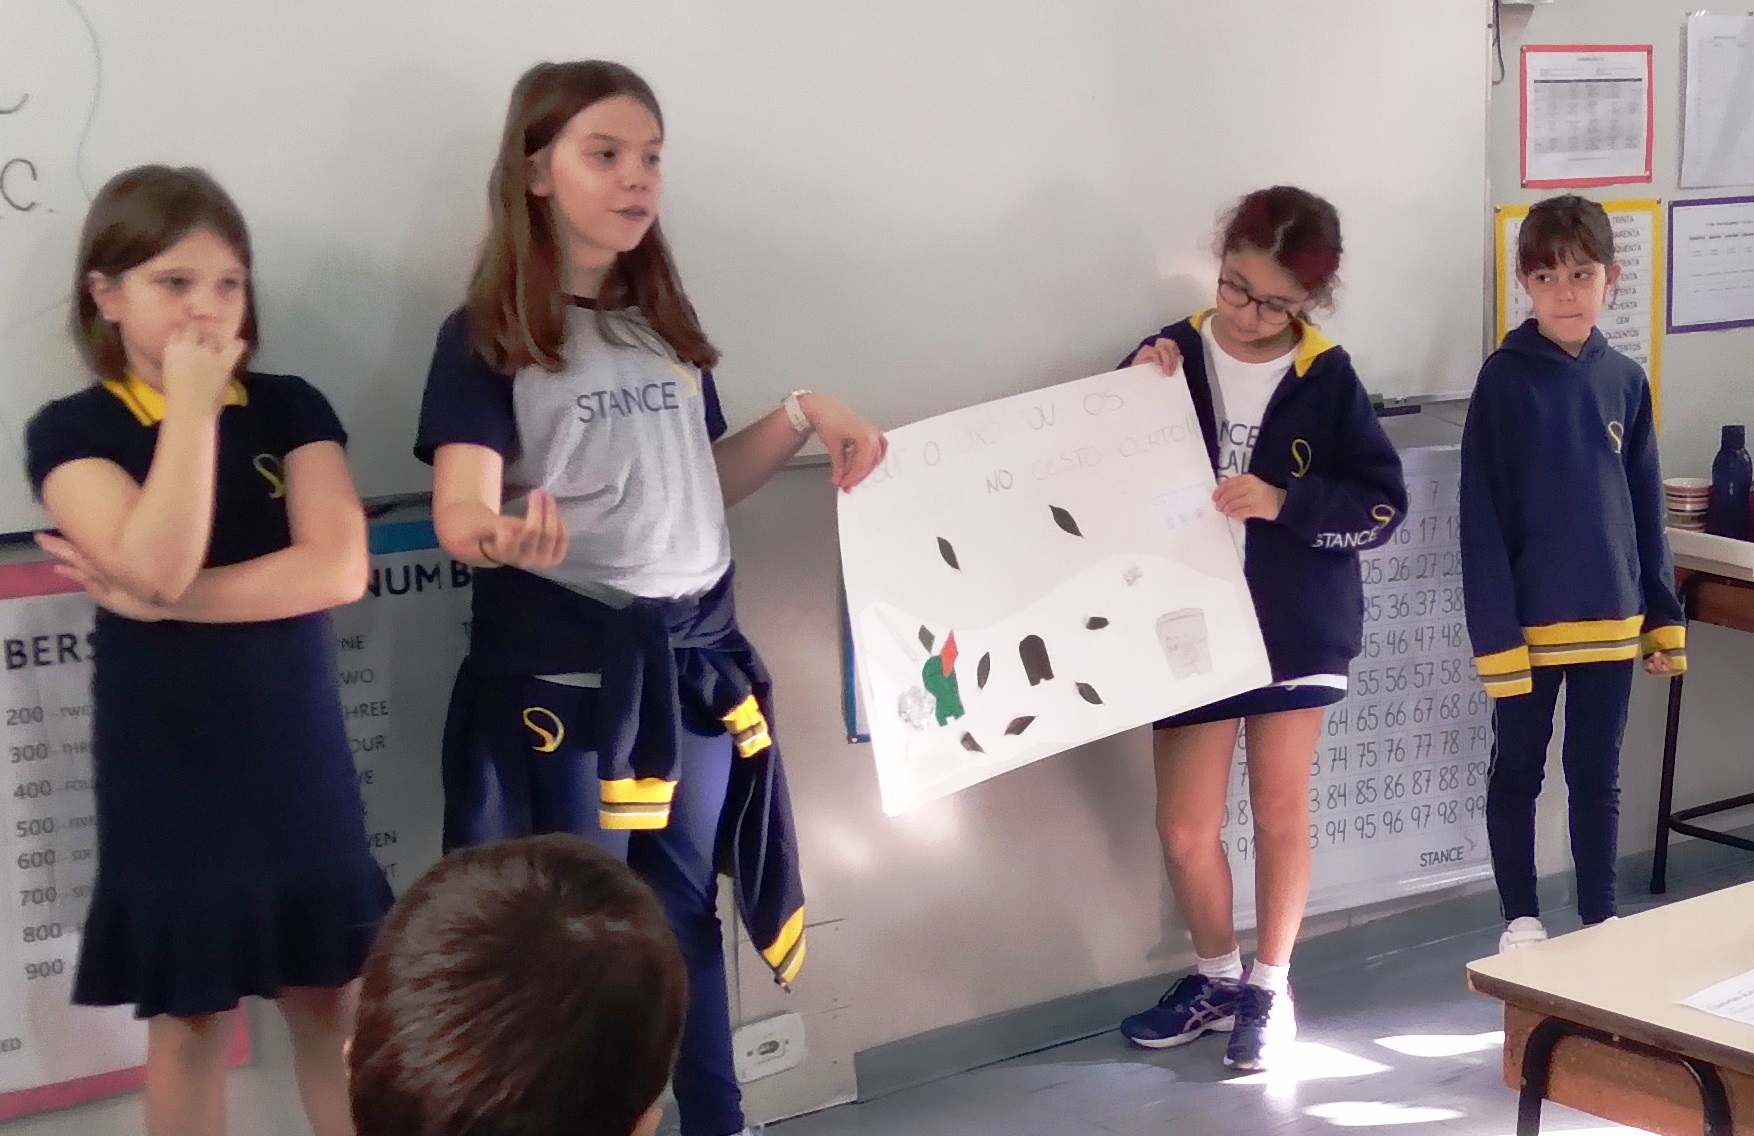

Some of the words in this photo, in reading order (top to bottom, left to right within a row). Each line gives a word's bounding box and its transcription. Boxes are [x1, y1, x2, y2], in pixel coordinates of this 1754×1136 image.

[576, 381, 680, 423] STANCE
[1220, 420, 1261, 448] NCE
[986, 469, 1014, 496] NO
[1312, 526, 1382, 549] STANCE
[1420, 516, 1437, 542] 17
[367, 559, 472, 598] NUMB
[1360, 559, 1382, 584] 25
[1388, 556, 1410, 582] 26
[1416, 553, 1437, 580] 27
[1443, 551, 1462, 576] 28
[1363, 596, 1381, 622] 35
[1387, 593, 1409, 619] 36
[1415, 589, 1436, 616] 37
[1442, 587, 1463, 613] 38
[340, 634, 366, 650] NE
[1387, 629, 1408, 656] 46
[1415, 626, 1434, 652] 47
[1441, 622, 1462, 649] 48
[4, 632, 97, 671] BERS
[340, 668, 375, 685] WO
[1357, 669, 1379, 696] 55
[1385, 666, 1407, 692] 56
[1413, 662, 1434, 688] 57
[1440, 658, 1461, 684] 58
[6, 705, 44, 726] 200
[343, 701, 390, 718] HREE
[1327, 708, 1349, 736] 64
[1356, 704, 1378, 731] 65
[1385, 702, 1406, 728] 66
[1413, 697, 1433, 723] 67
[1440, 693, 1460, 719] 68
[1467, 690, 1488, 715] 69
[11, 743, 49, 764] 300
[351, 734, 386, 753] OUR
[1328, 746, 1348, 773] 74
[1356, 741, 1377, 768] 75
[1384, 737, 1405, 763] 76
[1412, 733, 1432, 759] 77
[1440, 729, 1460, 754] 78
[1468, 725, 1487, 750] 79
[13, 779, 52, 799] 400
[1327, 782, 1347, 809] 84
[1355, 777, 1377, 804] 85
[1383, 774, 1405, 800] 86
[1412, 769, 1431, 795] 87
[1438, 765, 1459, 791] 88
[1466, 761, 1487, 786] 89
[16, 816, 55, 838] 500
[1325, 819, 1347, 844] 94
[1354, 813, 1376, 839] 95
[1382, 809, 1404, 835] 96
[1410, 804, 1431, 830] 97
[1437, 799, 1458, 824] 98
[1465, 795, 1486, 819] 99
[17, 848, 56, 869] 600
[1419, 846, 1465, 867] STANCE
[19, 886, 57, 906] 700
[23, 922, 62, 943] 800
[26, 958, 64, 980] 900
